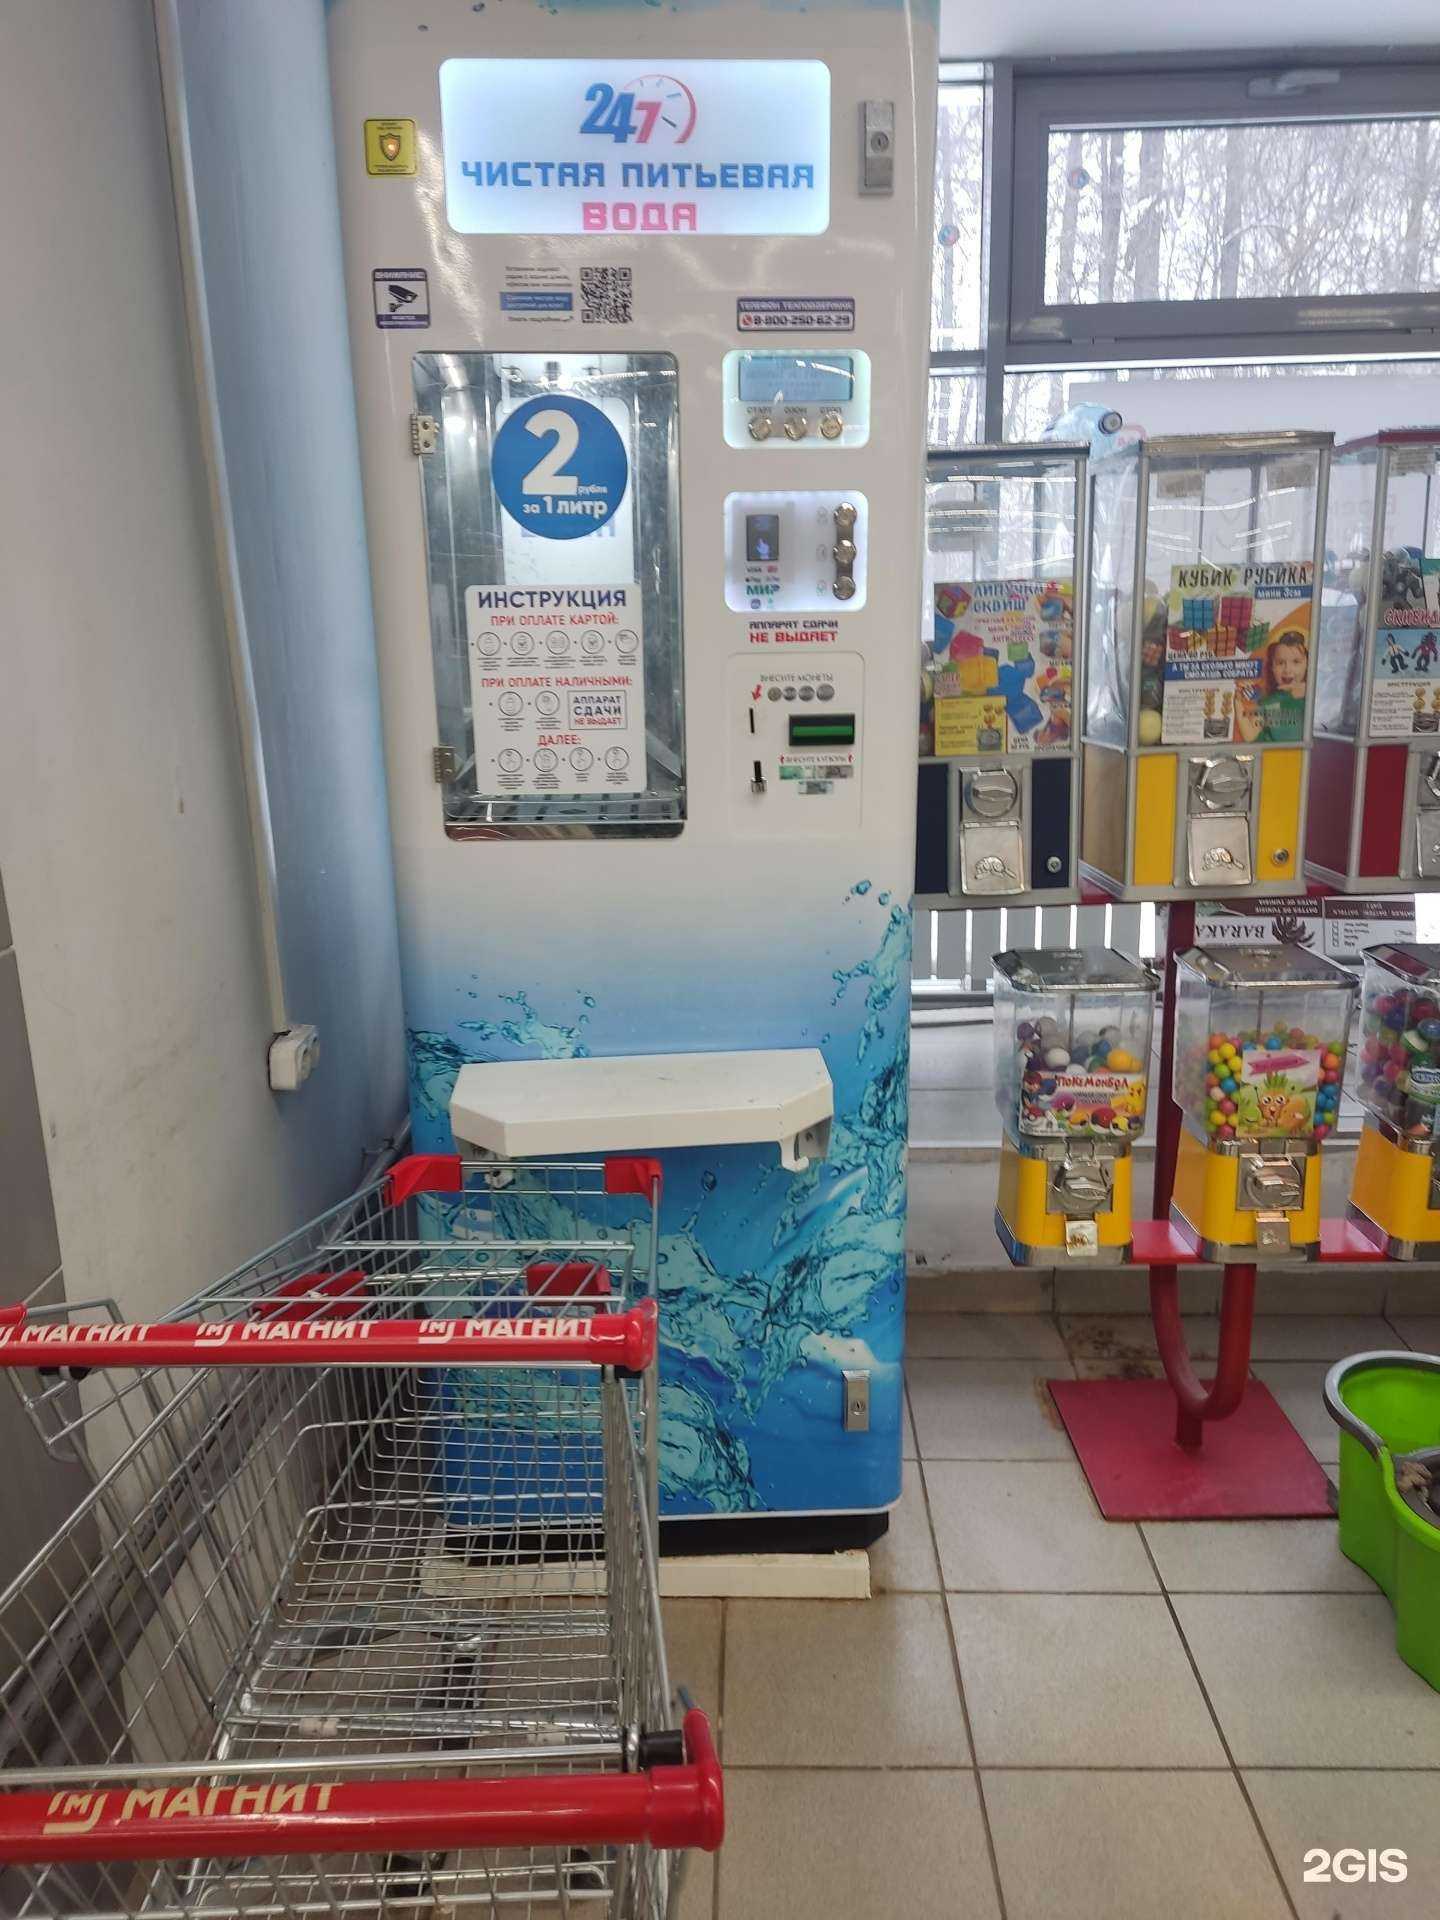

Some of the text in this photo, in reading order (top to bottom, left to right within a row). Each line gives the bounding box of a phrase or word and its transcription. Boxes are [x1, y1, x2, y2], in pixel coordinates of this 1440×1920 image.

[461, 160, 815, 189] ЧИСТАЯ ПИТЬЕВАЯ
[581, 202, 698, 232] ВОДА
[522, 409, 580, 496] 2
[522, 496, 608, 519] за 1 литр
[1178, 566, 1309, 588] КУБИК РУБИКА
[478, 589, 627, 610] ИНСТРУКЦИЯ
[491, 612, 620, 626] ПРИ ОПЛАТЕ КАРТОЙ:
[749, 620, 839, 629] АППАРАТ СДАЧИ
[749, 631, 837, 643] НЕ ВЫДАЕТ
[481, 675, 633, 687] ПРИ ОПЛАТЕ НАЛИЧНЫМИ:
[573, 695, 622, 704] АППАРАТ
[573, 705, 622, 717] СДАЧИ
[537, 734, 582, 747] ДАЛЕЕ:
[1195, 923, 1265, 939] BARAKA
[21, 1323, 157, 1344] МАГНИТ
[241, 1320, 379, 1341] МАГНИТ
[464, 1319, 593, 1339] МАГНИТ
[120, 1781, 346, 1822] МАГНИТ
